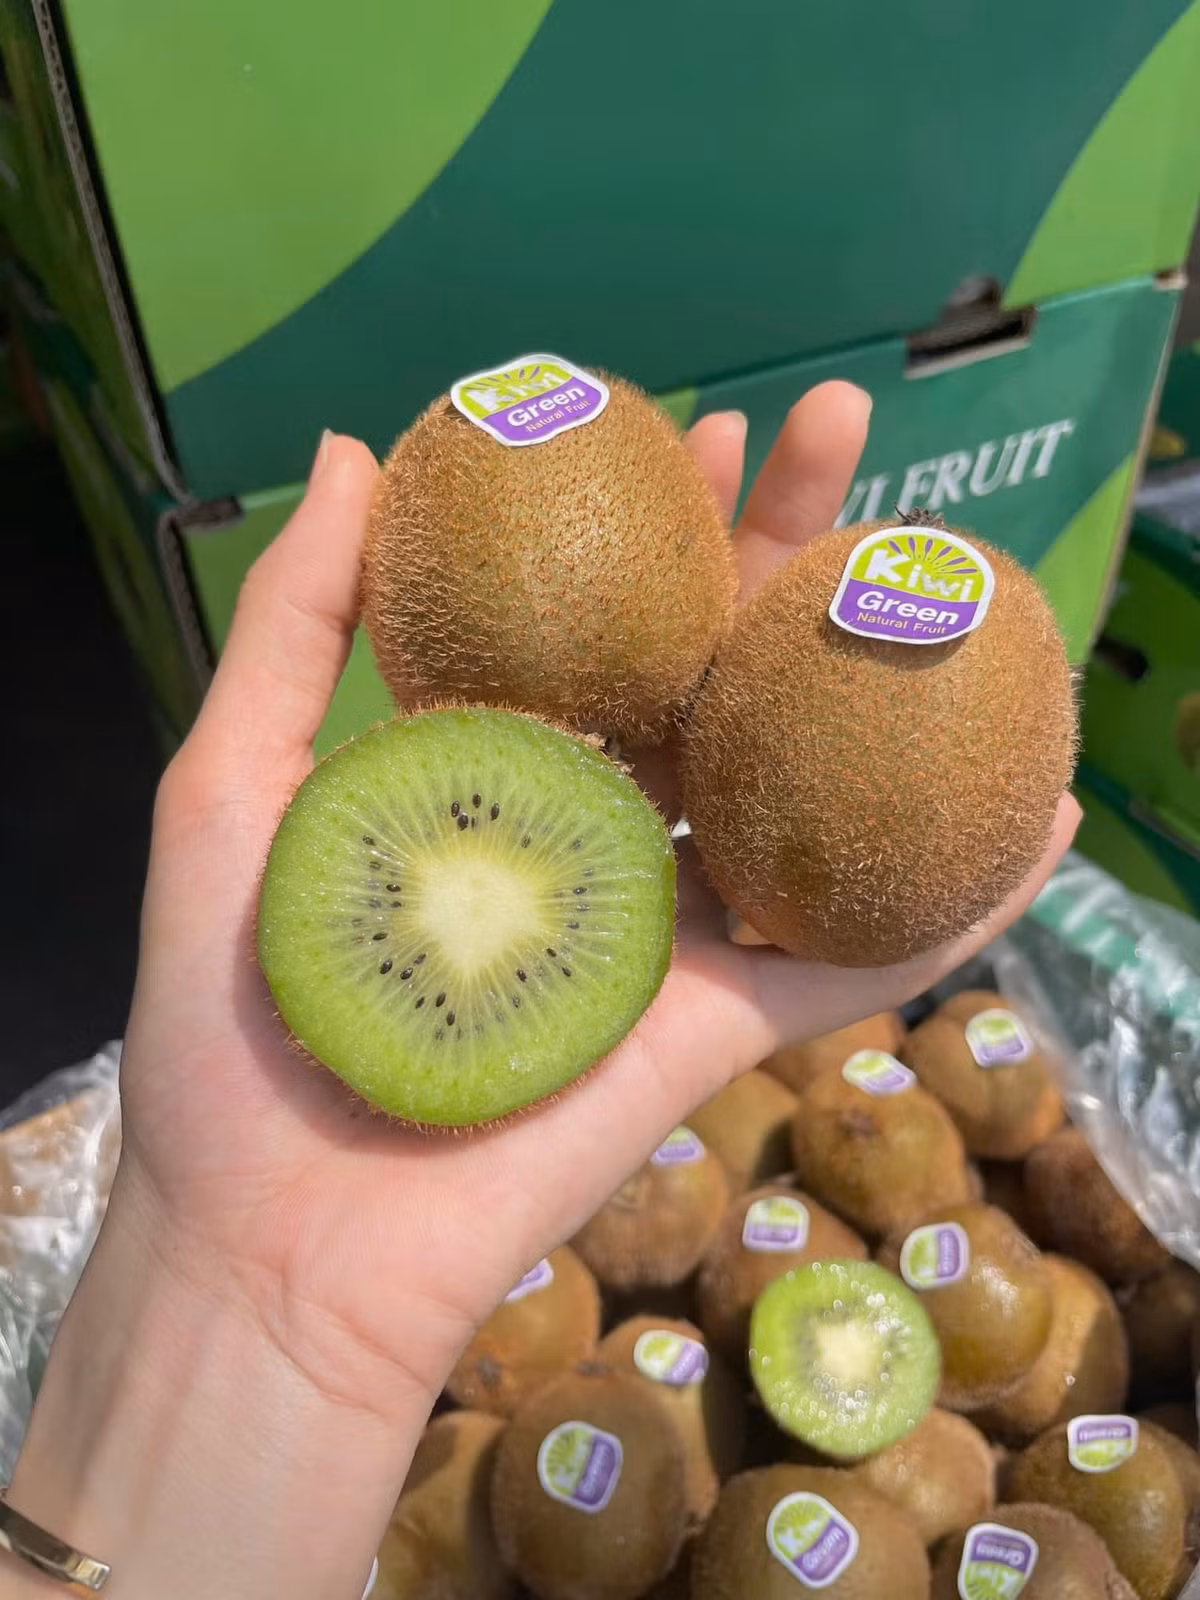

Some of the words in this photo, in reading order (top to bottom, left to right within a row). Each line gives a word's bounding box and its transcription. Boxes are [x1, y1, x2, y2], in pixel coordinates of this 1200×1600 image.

[507, 386, 586, 427] Green
[525, 410, 565, 433] Natural
[567, 400, 591, 414] Fruit
[895, 418, 1077, 517] FRUIT
[864, 549, 975, 602] Kiwi
[856, 590, 960, 625] Green
[857, 612, 908, 630] Natural
[913, 623, 947, 635] Fruit
